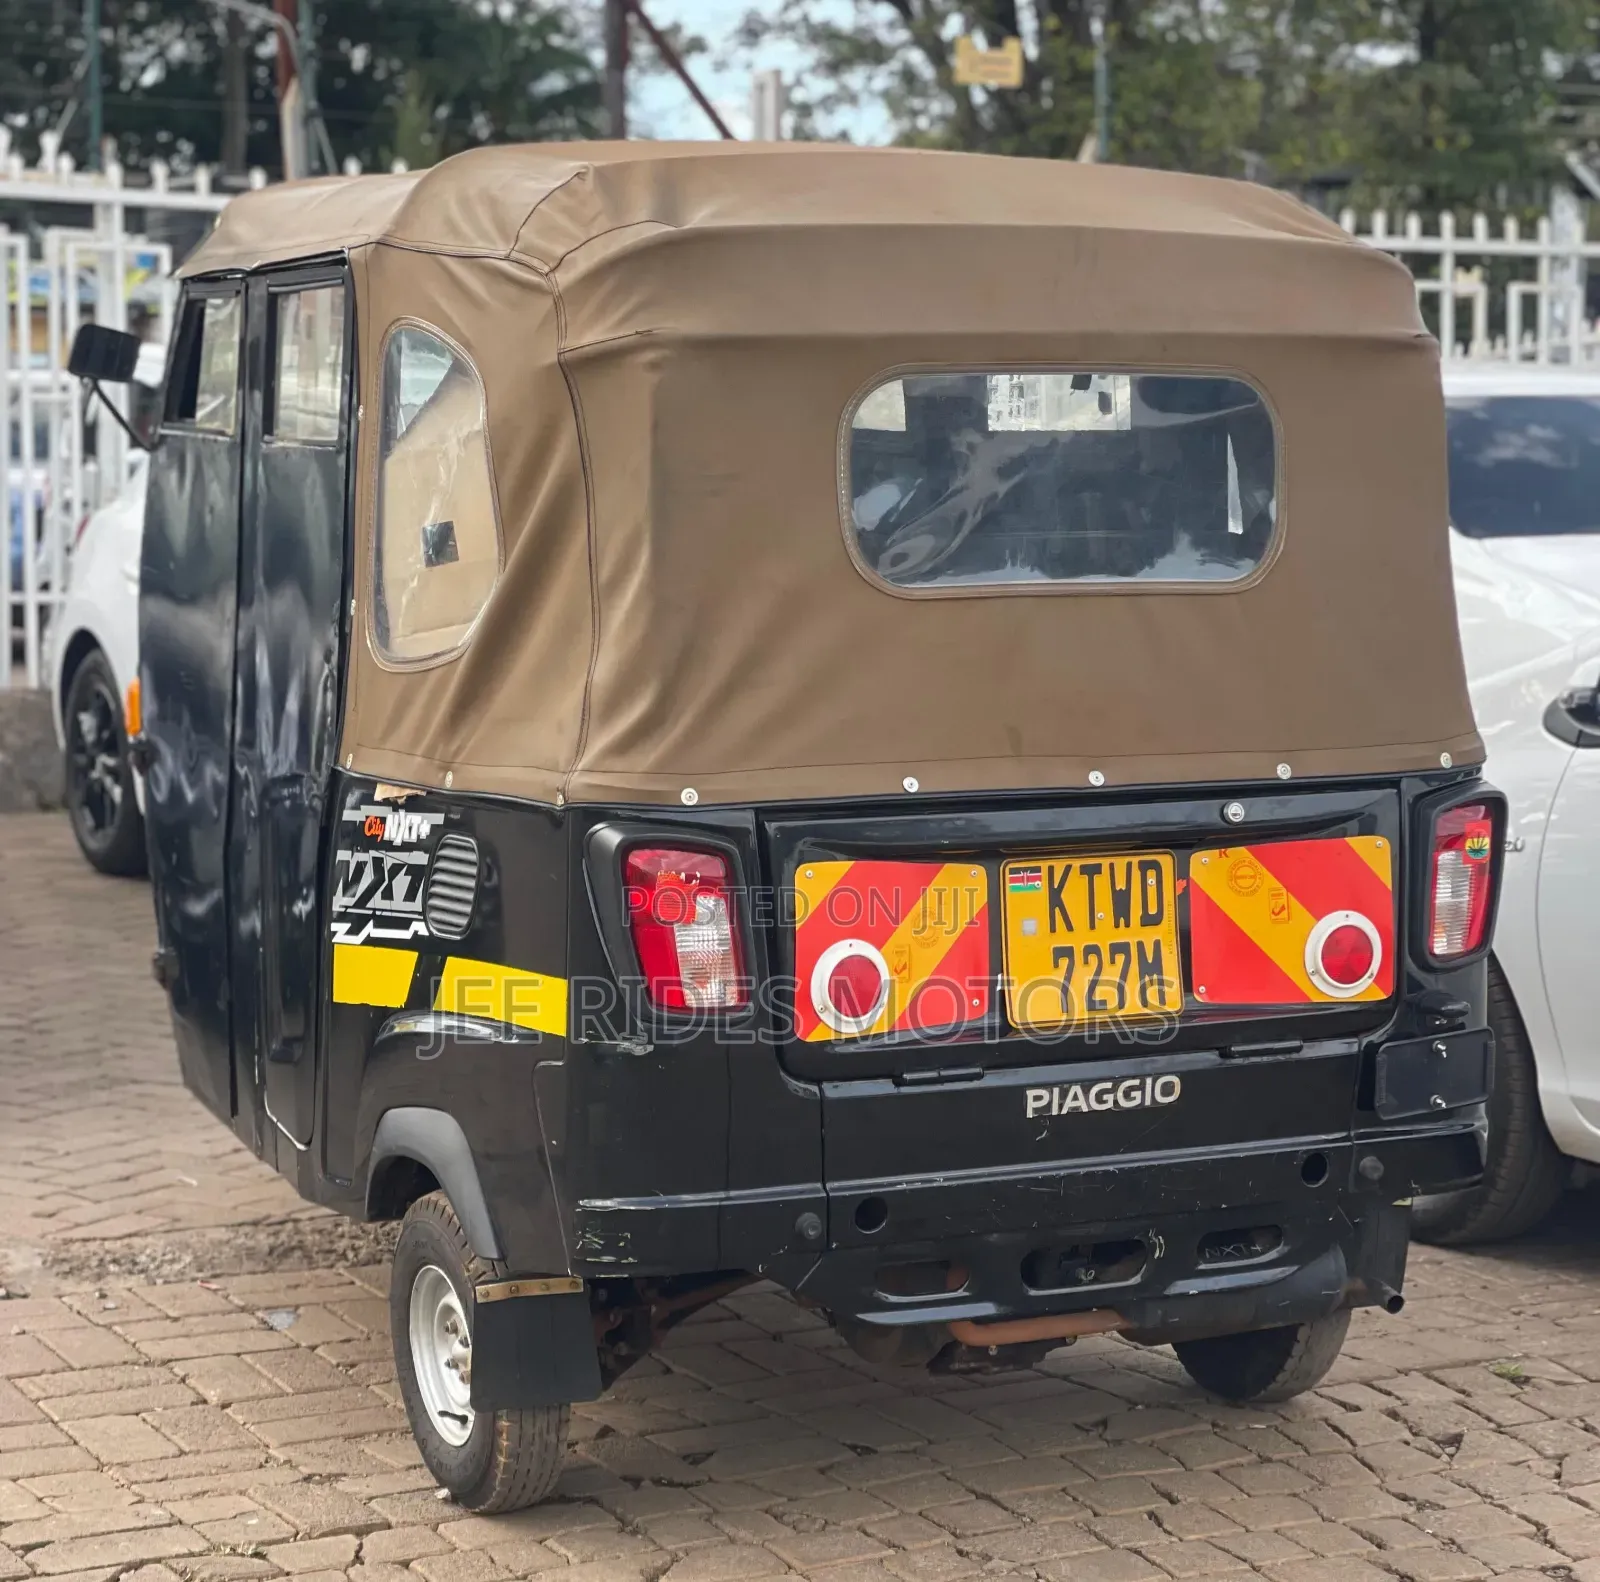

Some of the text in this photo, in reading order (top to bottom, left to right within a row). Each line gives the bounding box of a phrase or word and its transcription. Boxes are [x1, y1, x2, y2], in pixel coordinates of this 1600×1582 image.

[364, 808, 432, 846] City NXT+
[1047, 859, 1164, 933] KTWD
[1052, 938, 1167, 1014] 727M
[1025, 1074, 1182, 1118] PIAGGIO
